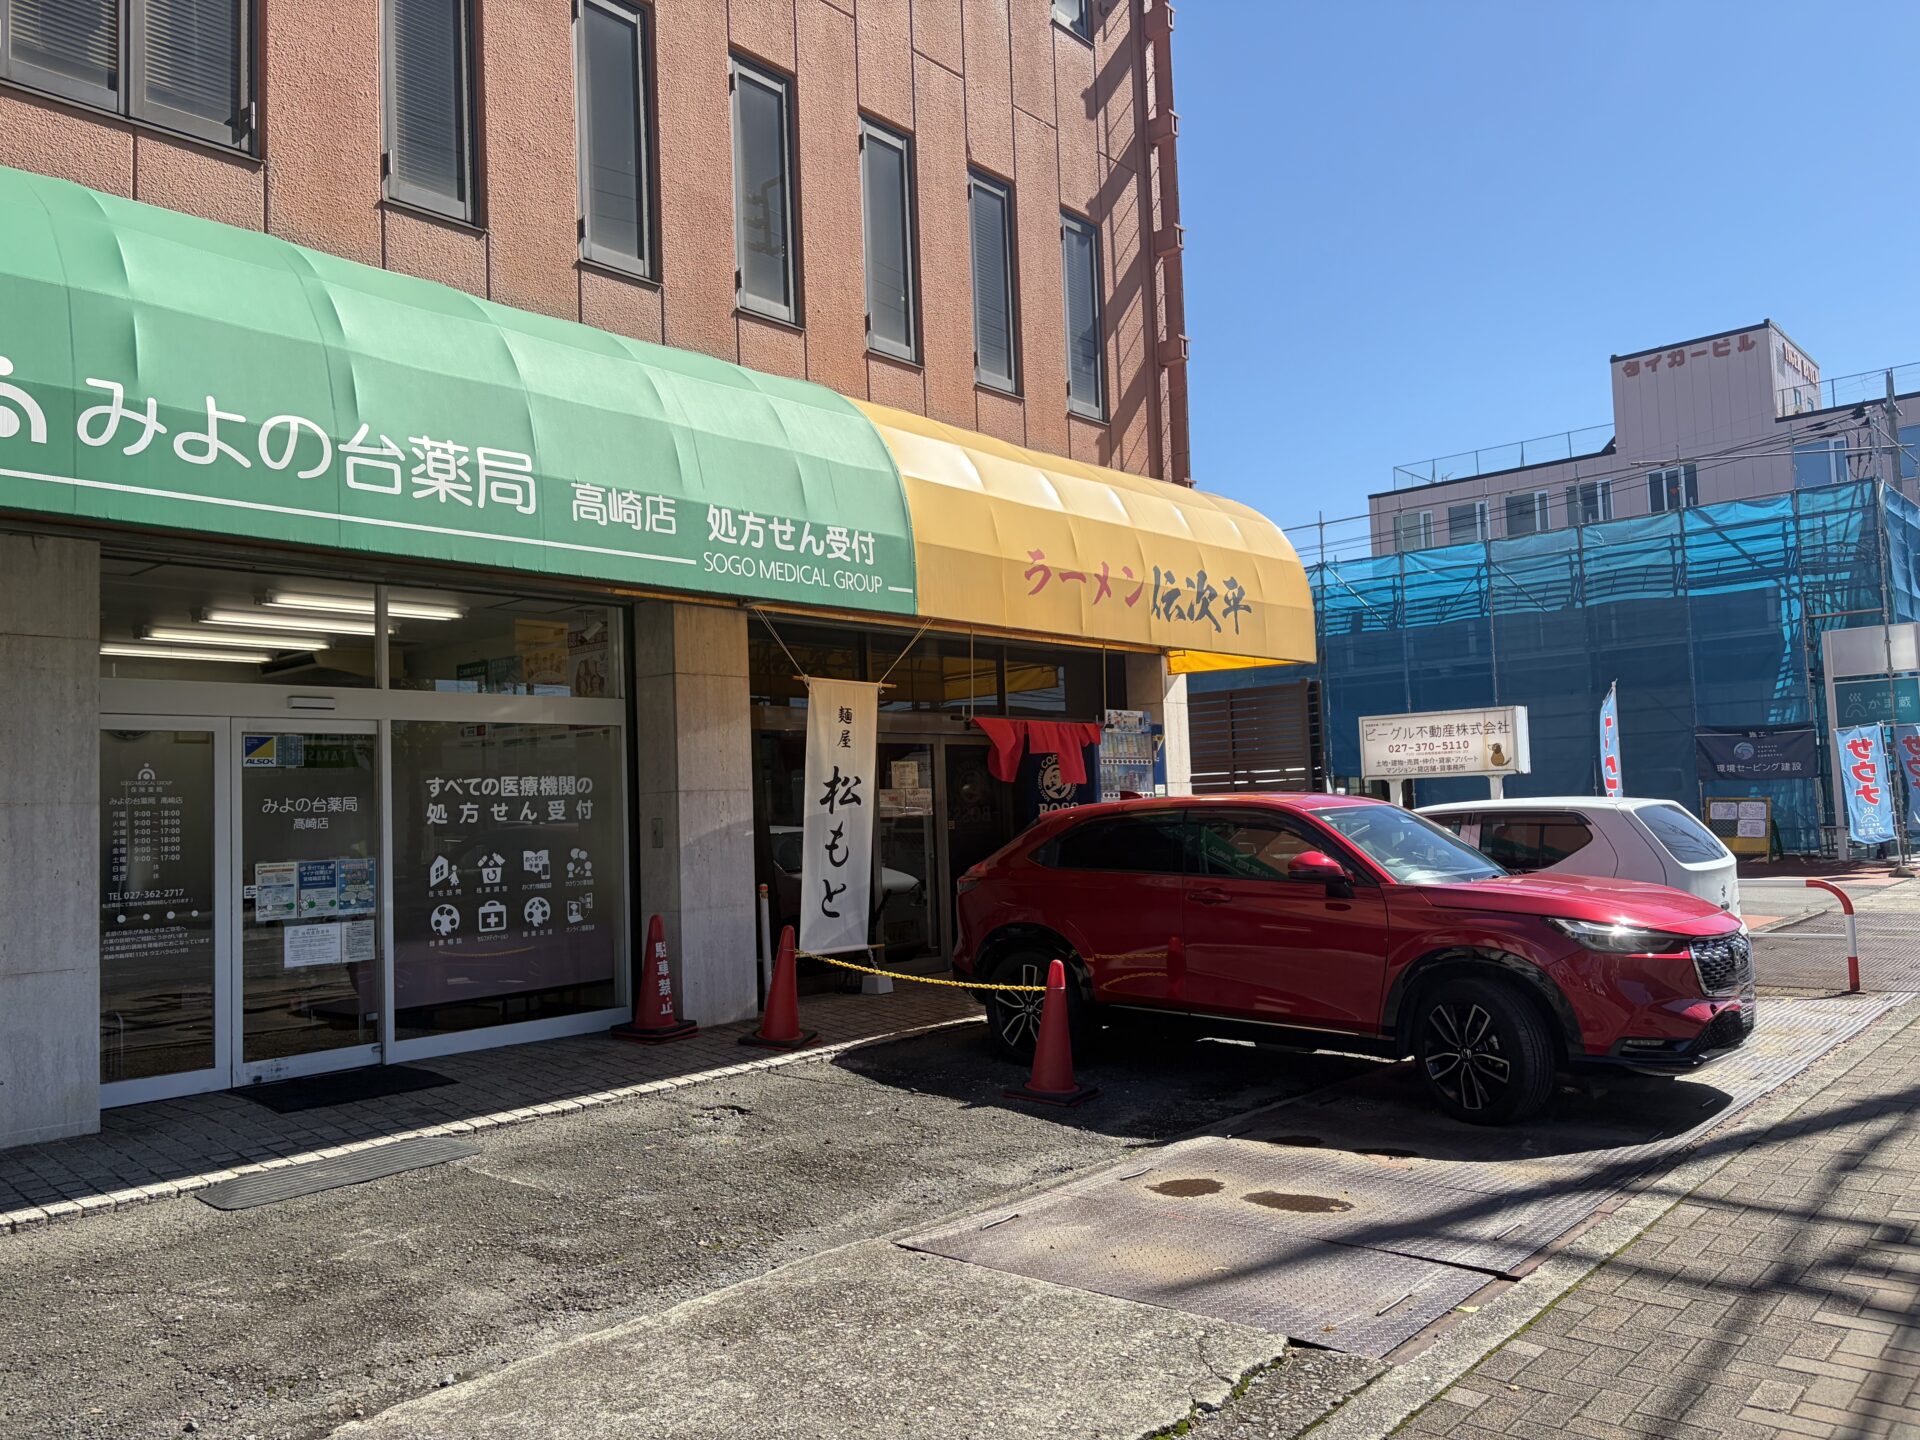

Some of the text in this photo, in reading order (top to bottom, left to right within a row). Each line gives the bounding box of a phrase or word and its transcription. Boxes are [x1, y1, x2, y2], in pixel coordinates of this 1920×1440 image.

[1622, 333, 1757, 377] タイガービル
[77, 377, 876, 566] みよの台薬局 高崎店 処方せん受付
[703, 552, 882, 593] SOGO MEDICAL GROUP
[1024, 548, 1252, 635] ラーメン 伝次平
[1365, 721, 1511, 742] ビーグル不動産株式会社
[1388, 740, 1470, 753] 027-370-5110
[1716, 761, 1803, 773] 環境セービング建設
[426, 776, 593, 797] すべての医療機関の
[109, 796, 183, 805] みよの台薬局 高崎店
[262, 796, 358, 814] みよの台薬局
[426, 800, 594, 825] 処方せん受付
[819, 706, 862, 918] 麺屋 松もと
[293, 818, 329, 830] 高崎店
[108, 888, 184, 901] TEL 027-362-2717
[655, 941, 673, 1015] 駐車禁止
